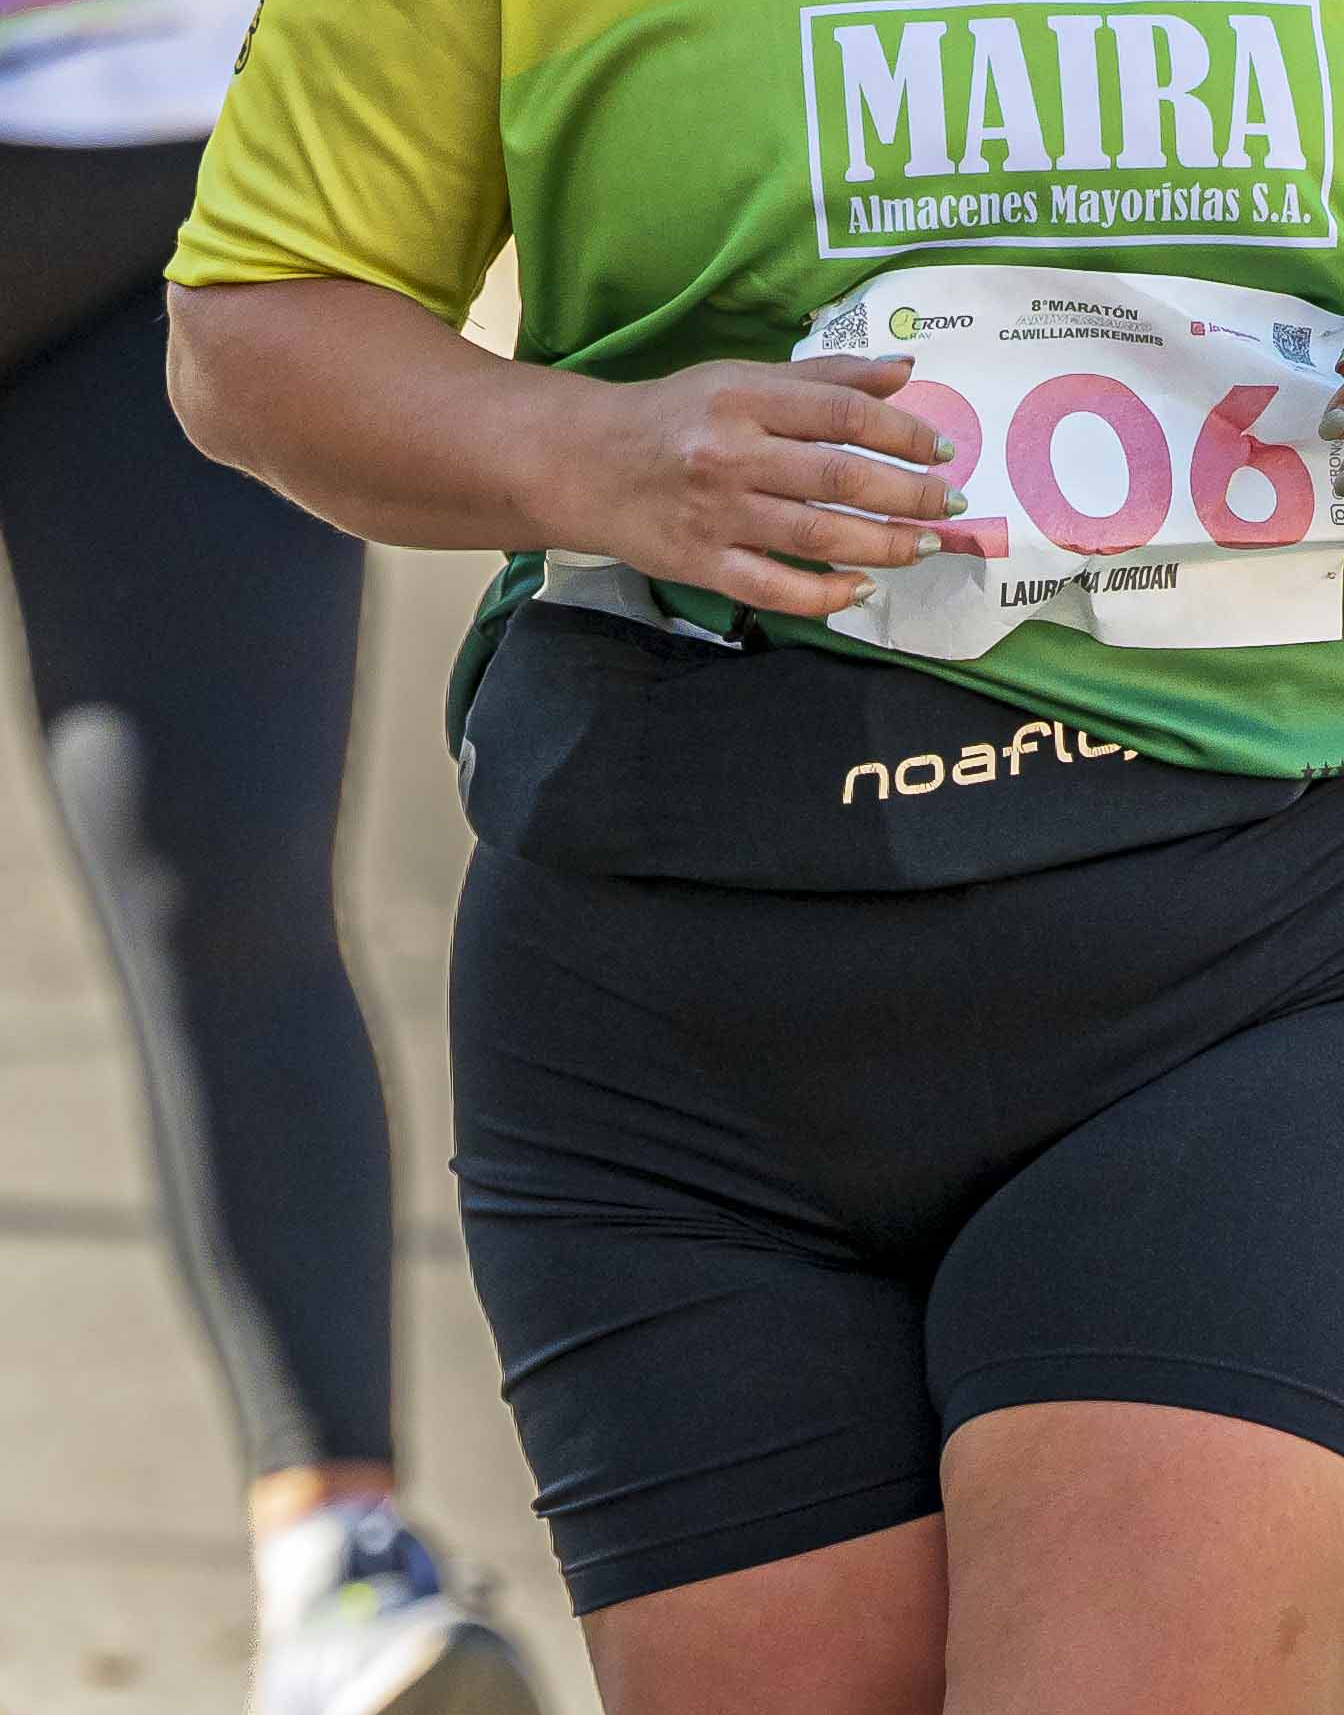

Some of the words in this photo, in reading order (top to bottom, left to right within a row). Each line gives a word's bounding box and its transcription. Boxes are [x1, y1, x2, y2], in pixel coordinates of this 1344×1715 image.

[833, 14, 1307, 182] MAIRA
[848, 191, 1038, 234] Almacenes
[1050, 182, 1240, 228] Mayoristas
[1252, 183, 1312, 224] S.A.
[998, 329, 1164, 347] CAWILLIAMSKEMMIS
[883, 373, 1315, 556] 206
[1102, 563, 1178, 592] JORDAN
